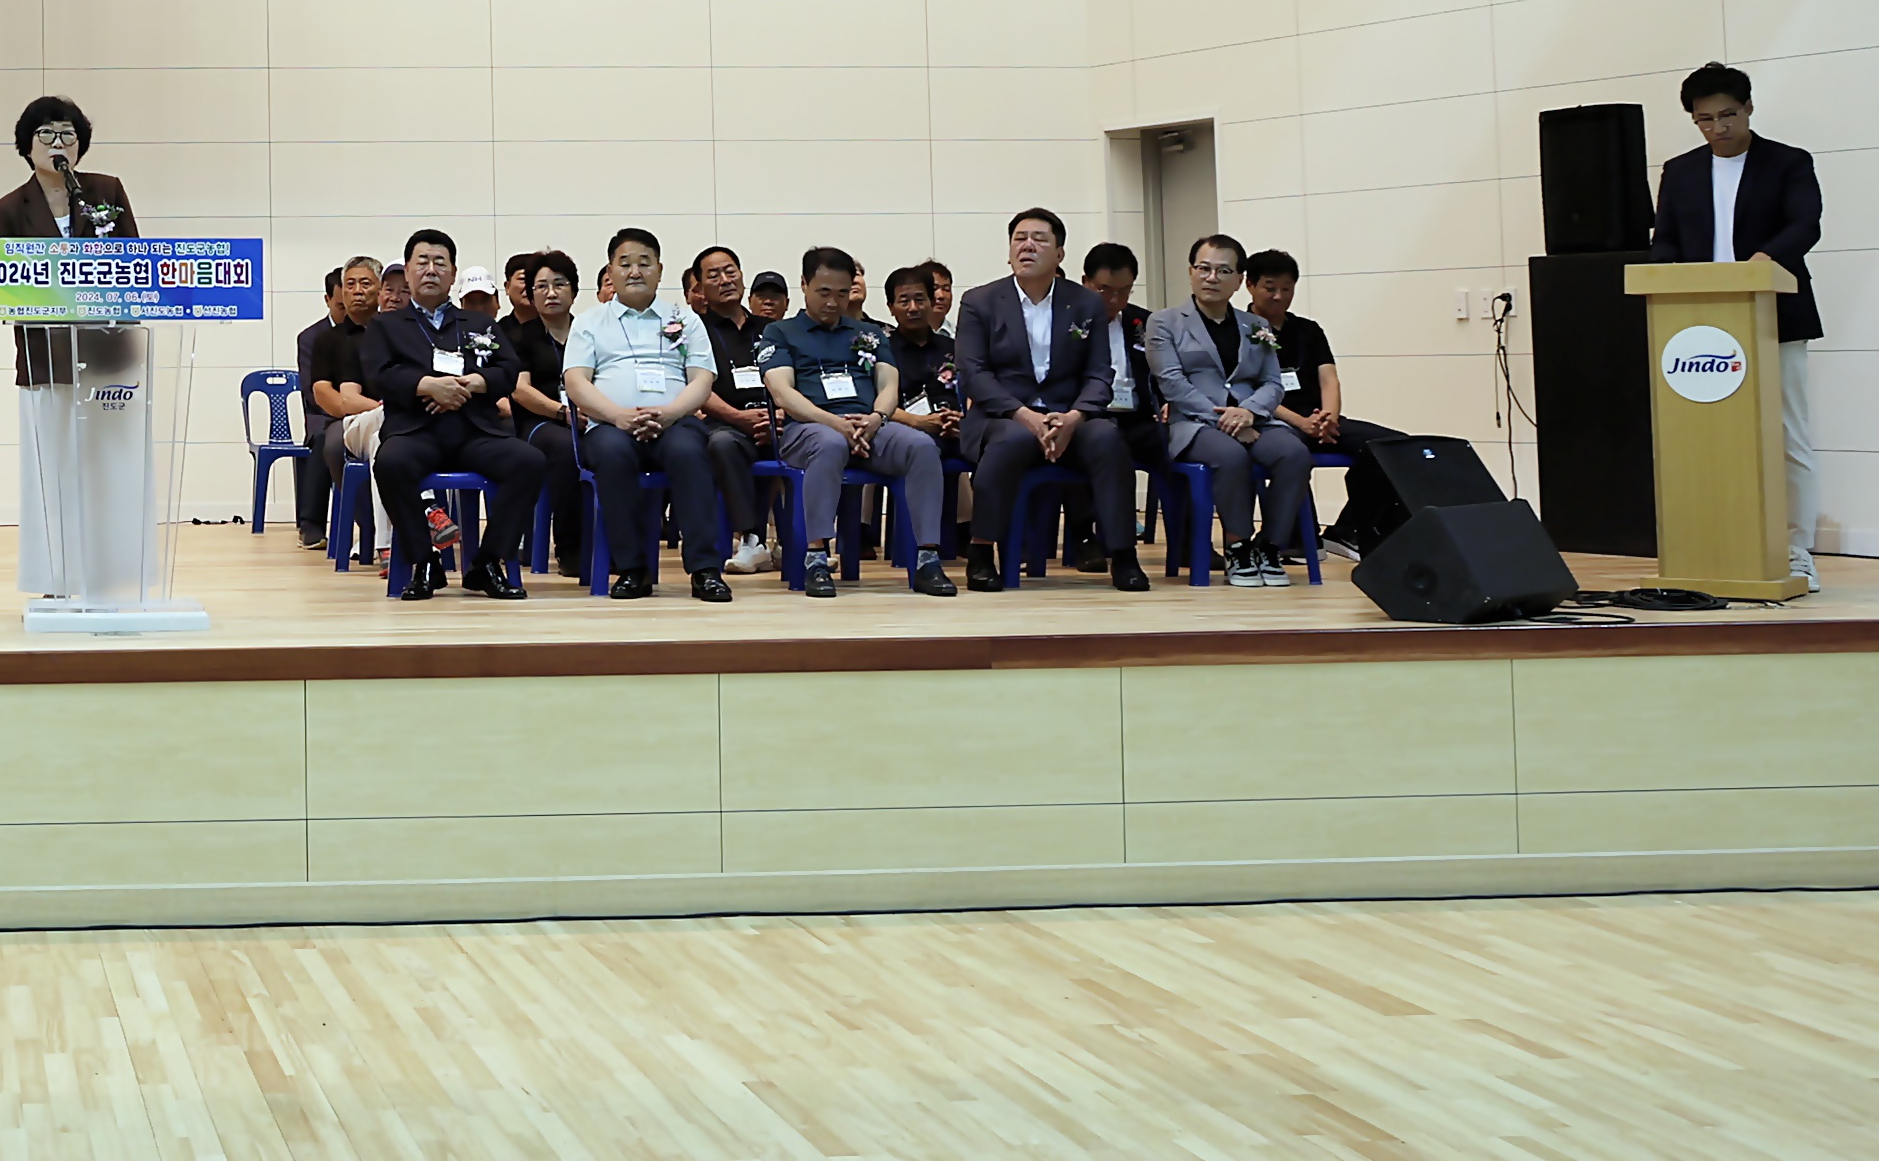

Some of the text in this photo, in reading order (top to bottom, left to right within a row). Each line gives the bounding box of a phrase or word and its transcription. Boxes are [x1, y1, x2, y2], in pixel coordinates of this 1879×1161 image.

[5, 243, 45, 254] 임직원간
[84, 243, 123, 255] 화합으로
[128, 244, 148, 254] 하나
[152, 244, 172, 255] 되는
[176, 244, 230, 255] 진도군농협!
[60, 262, 149, 285] 진도군농협
[160, 262, 249, 285] 한마음대회
[1667, 358, 1729, 374] Jindo
[85, 387, 133, 401] Jindo
